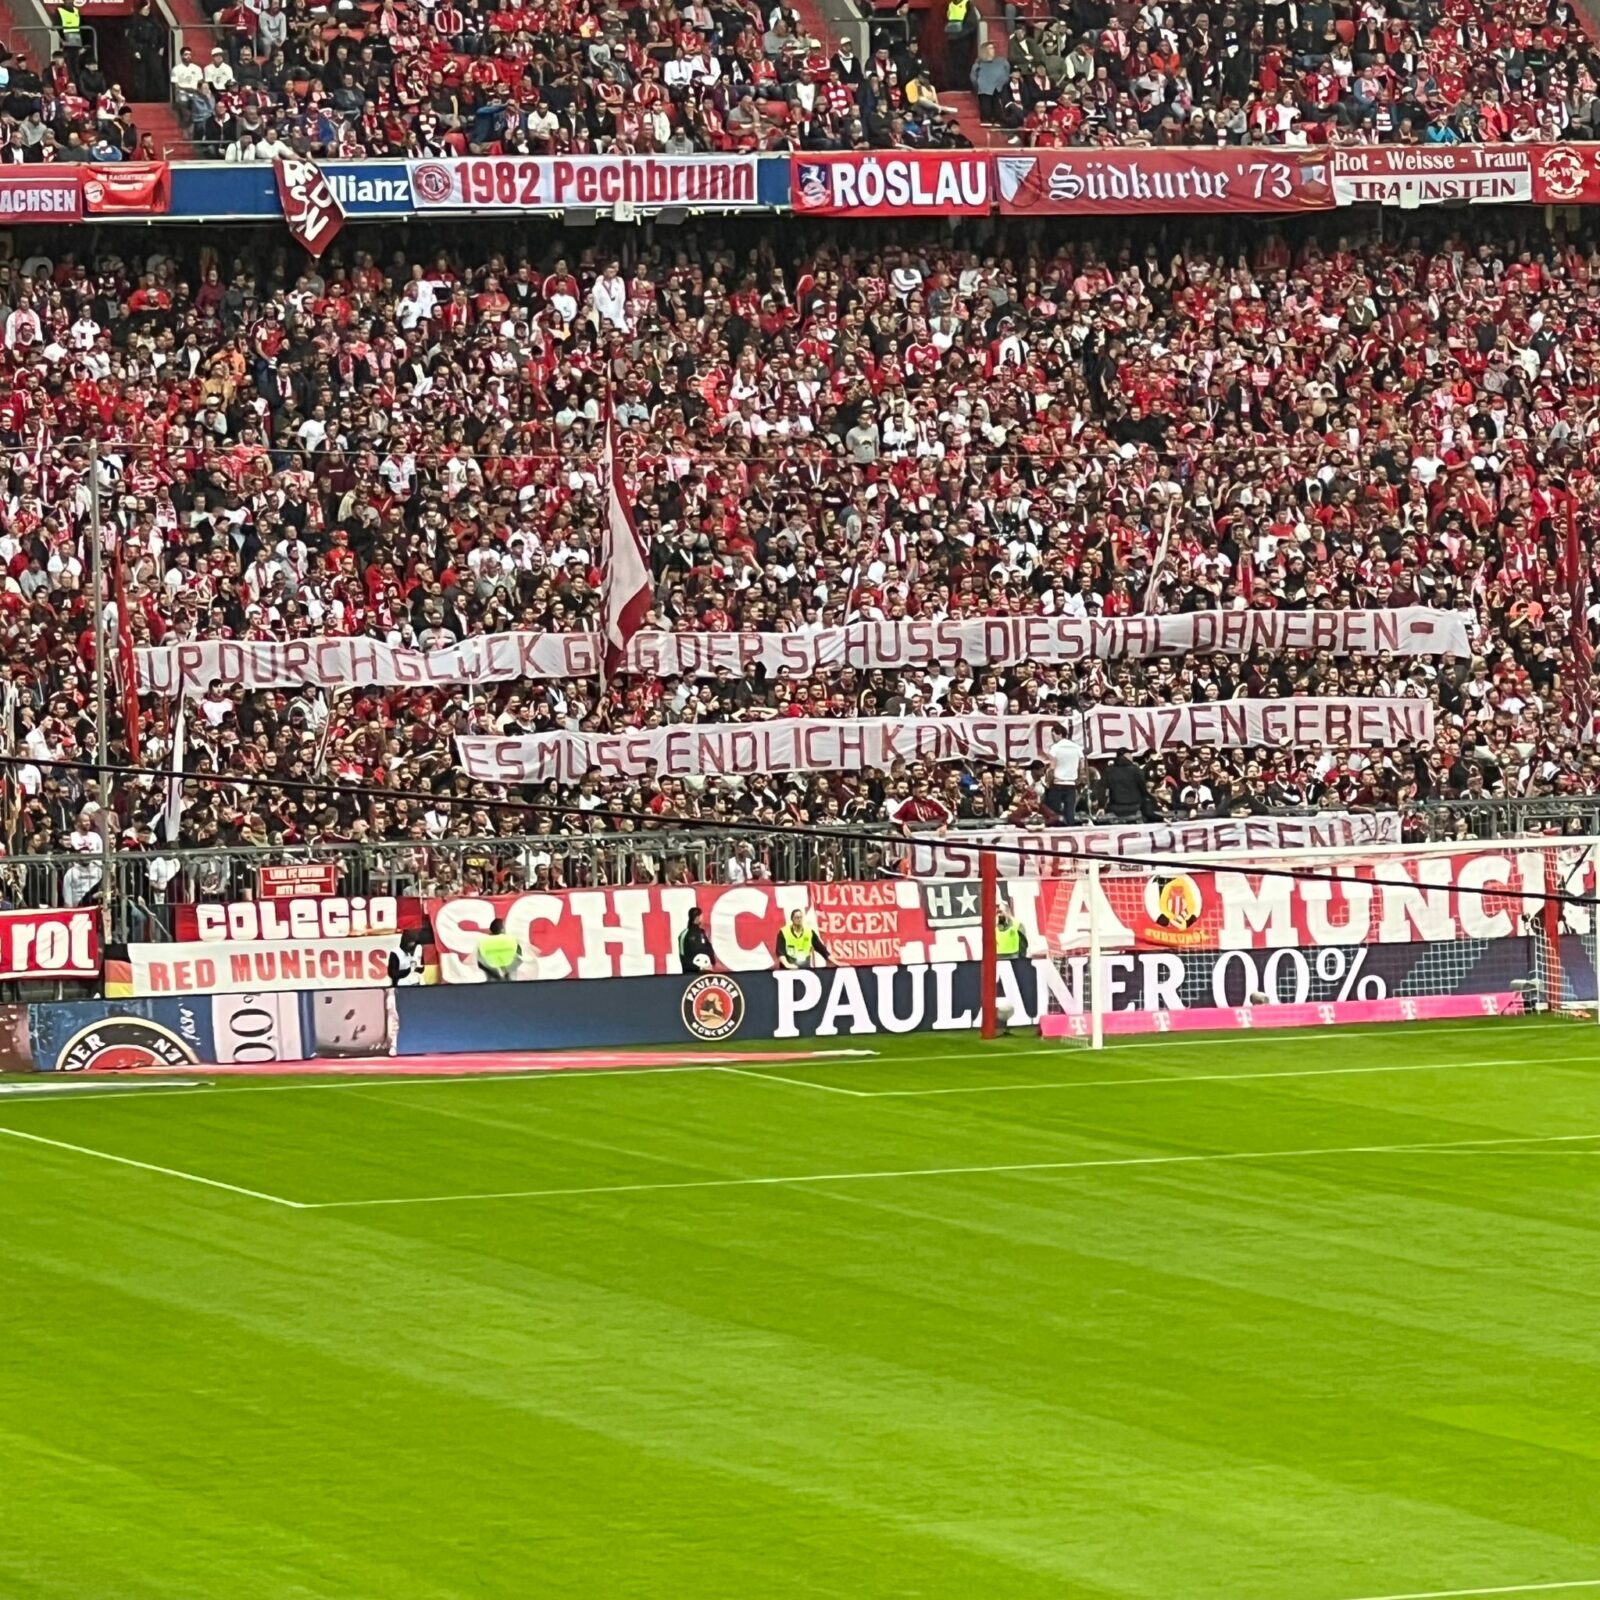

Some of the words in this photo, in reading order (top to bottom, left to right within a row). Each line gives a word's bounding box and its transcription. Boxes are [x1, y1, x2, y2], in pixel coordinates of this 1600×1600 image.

[1335, 152, 1368, 171] Rot
[1387, 151, 1455, 170] Weisse
[1471, 150, 1527, 168] Traun
[327, 175, 409, 203] llianz
[454, 161, 541, 203] 1982
[553, 159, 751, 202] Pechbrunn
[831, 157, 987, 207] RÖSLAU
[1049, 162, 1230, 200] Südkurve
[1237, 162, 1293, 199] '73
[1350, 178, 1516, 200] TRANSTEIN
[219, 641, 377, 683] DURCH
[563, 633, 660, 674] GIG
[676, 633, 764, 672] DER
[782, 621, 962, 673] SCHUSS
[986, 617, 1176, 662] DIESMAL
[1193, 611, 1399, 650] DANEBEN
[462, 740, 523, 780] ES
[666, 724, 865, 774] ENDLICH
[816, 910, 898, 934] GEGEN
[12, 913, 95, 971] rot
[826, 937, 901, 960] ASSISMUS
[149, 957, 216, 992] RED
[687, 977, 739, 1001] PAULANER
[773, 952, 1188, 1038] PAULANER
